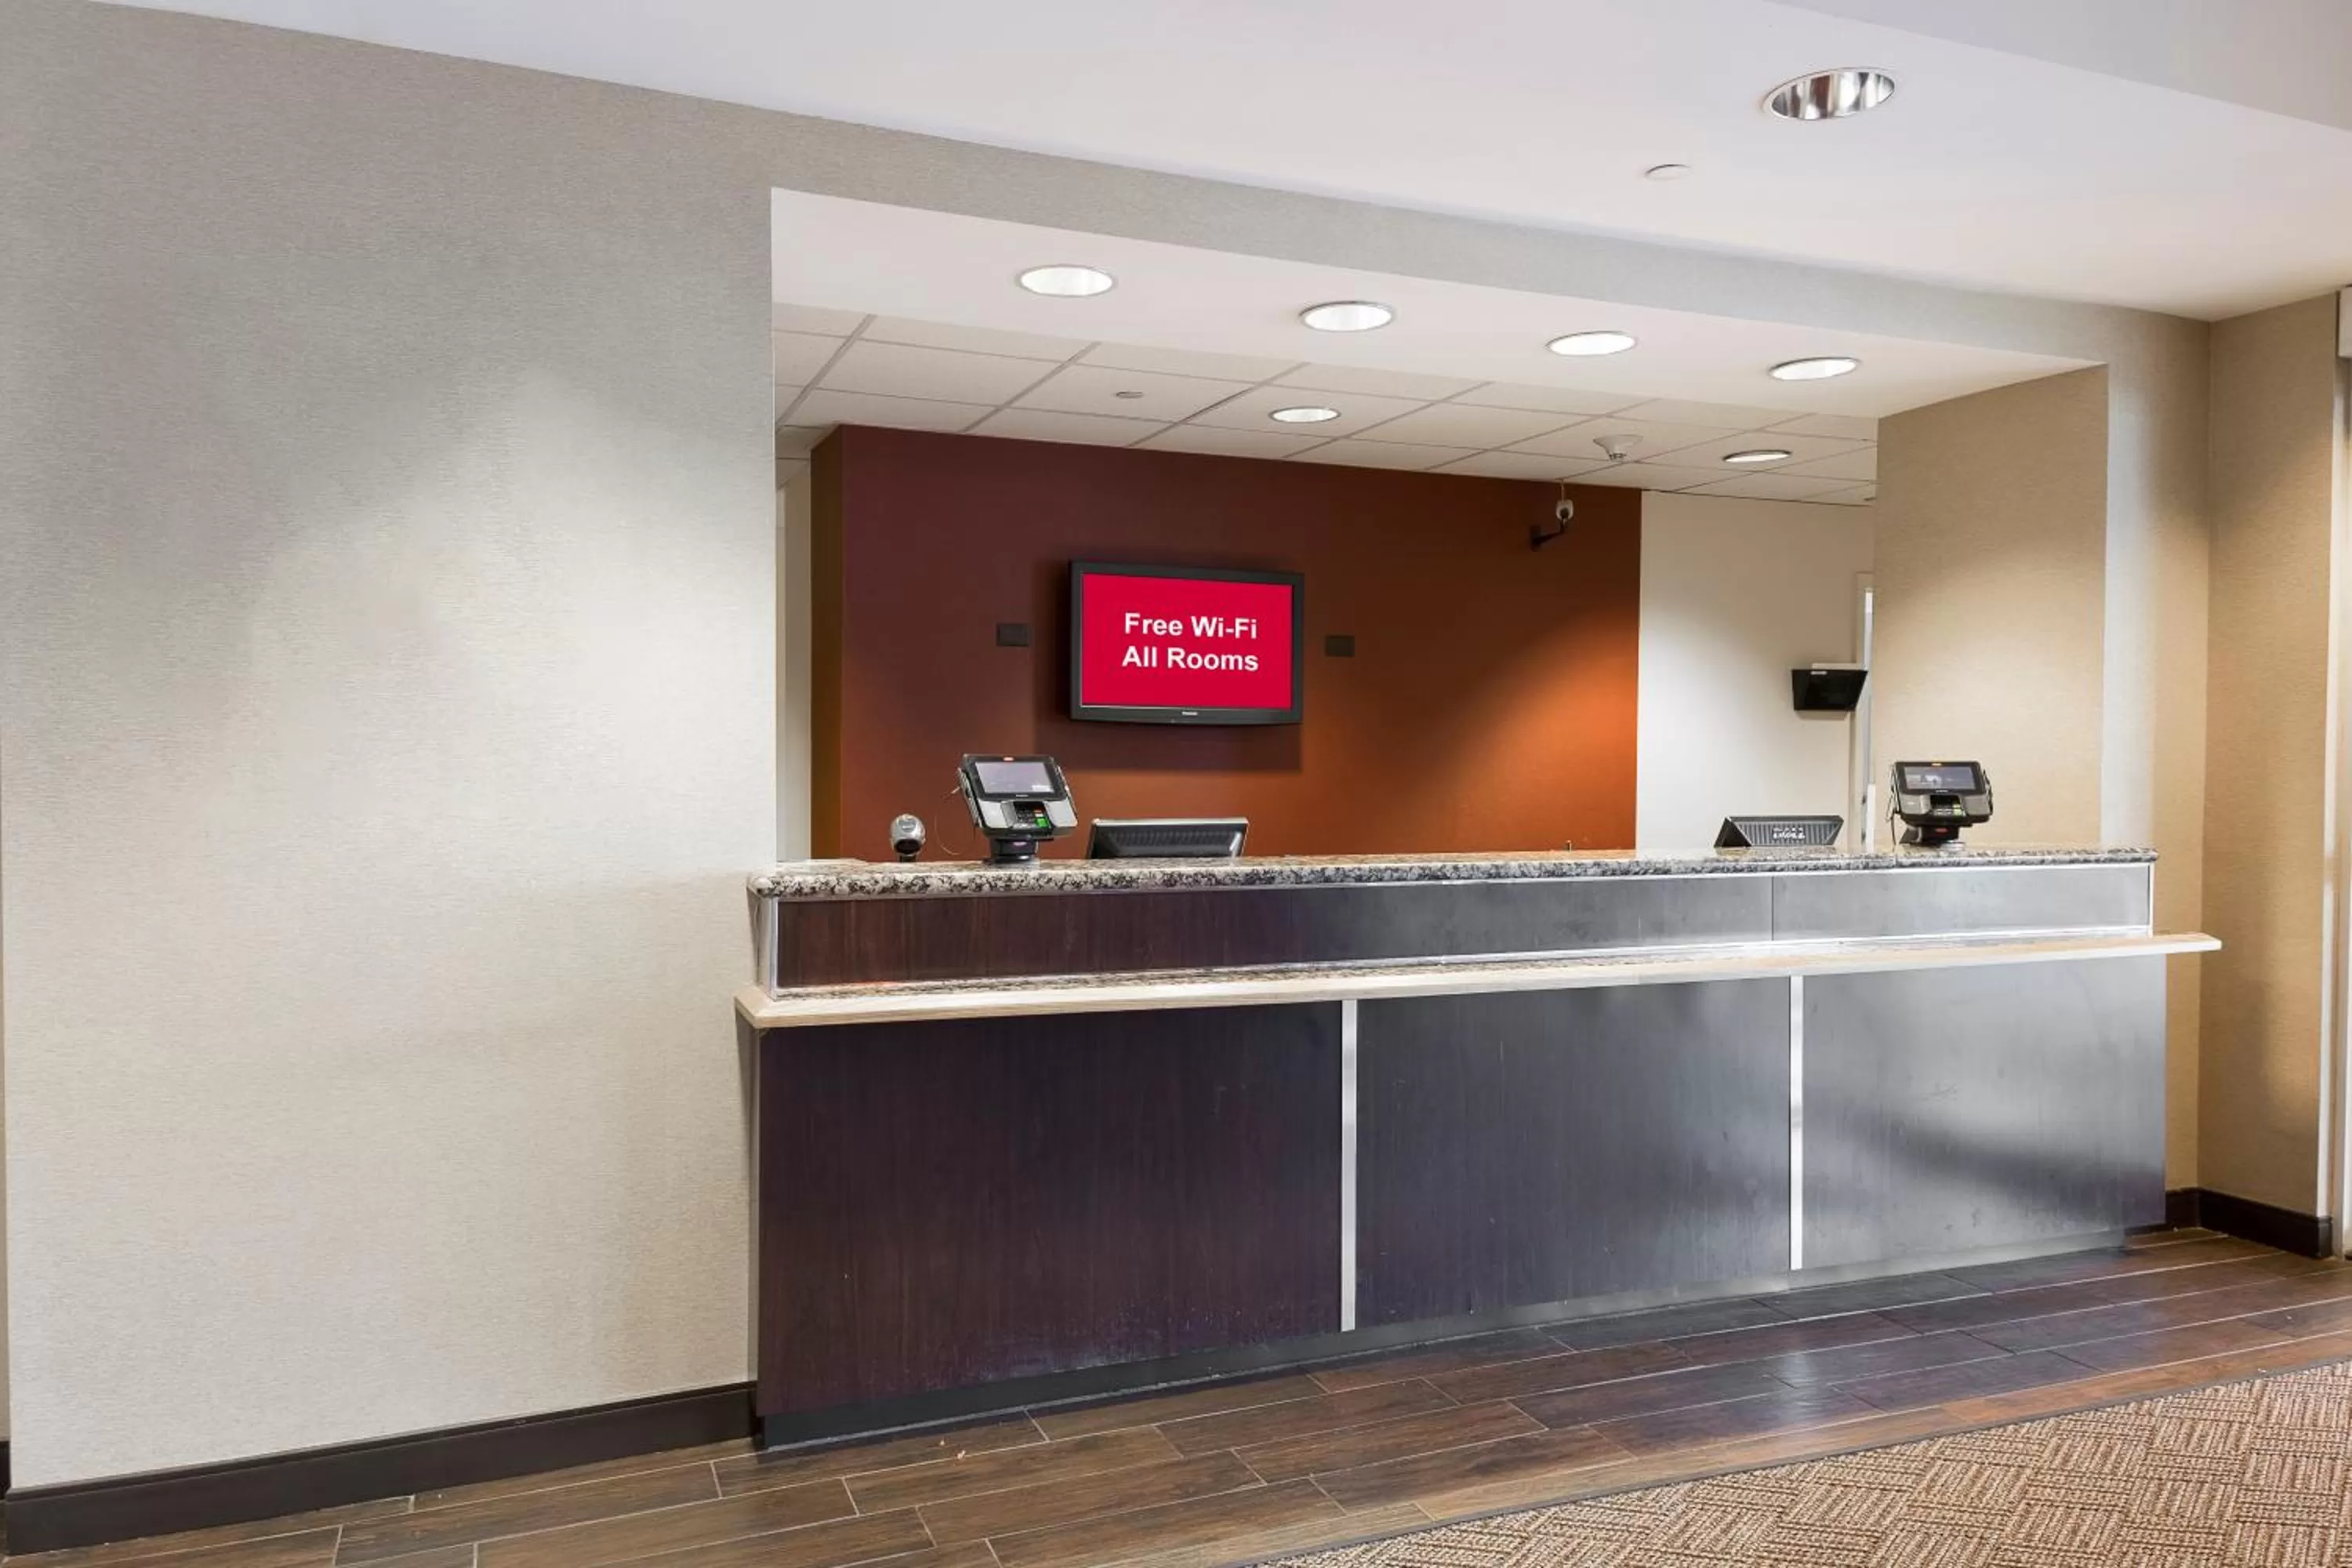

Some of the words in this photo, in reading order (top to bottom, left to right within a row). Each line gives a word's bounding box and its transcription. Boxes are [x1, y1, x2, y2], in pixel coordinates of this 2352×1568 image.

[1125, 612, 1183, 636] Free
[1191, 615, 1257, 639] Wi-Fi
[1122, 645, 1157, 668] All
[1167, 647, 1258, 672] Rooms
